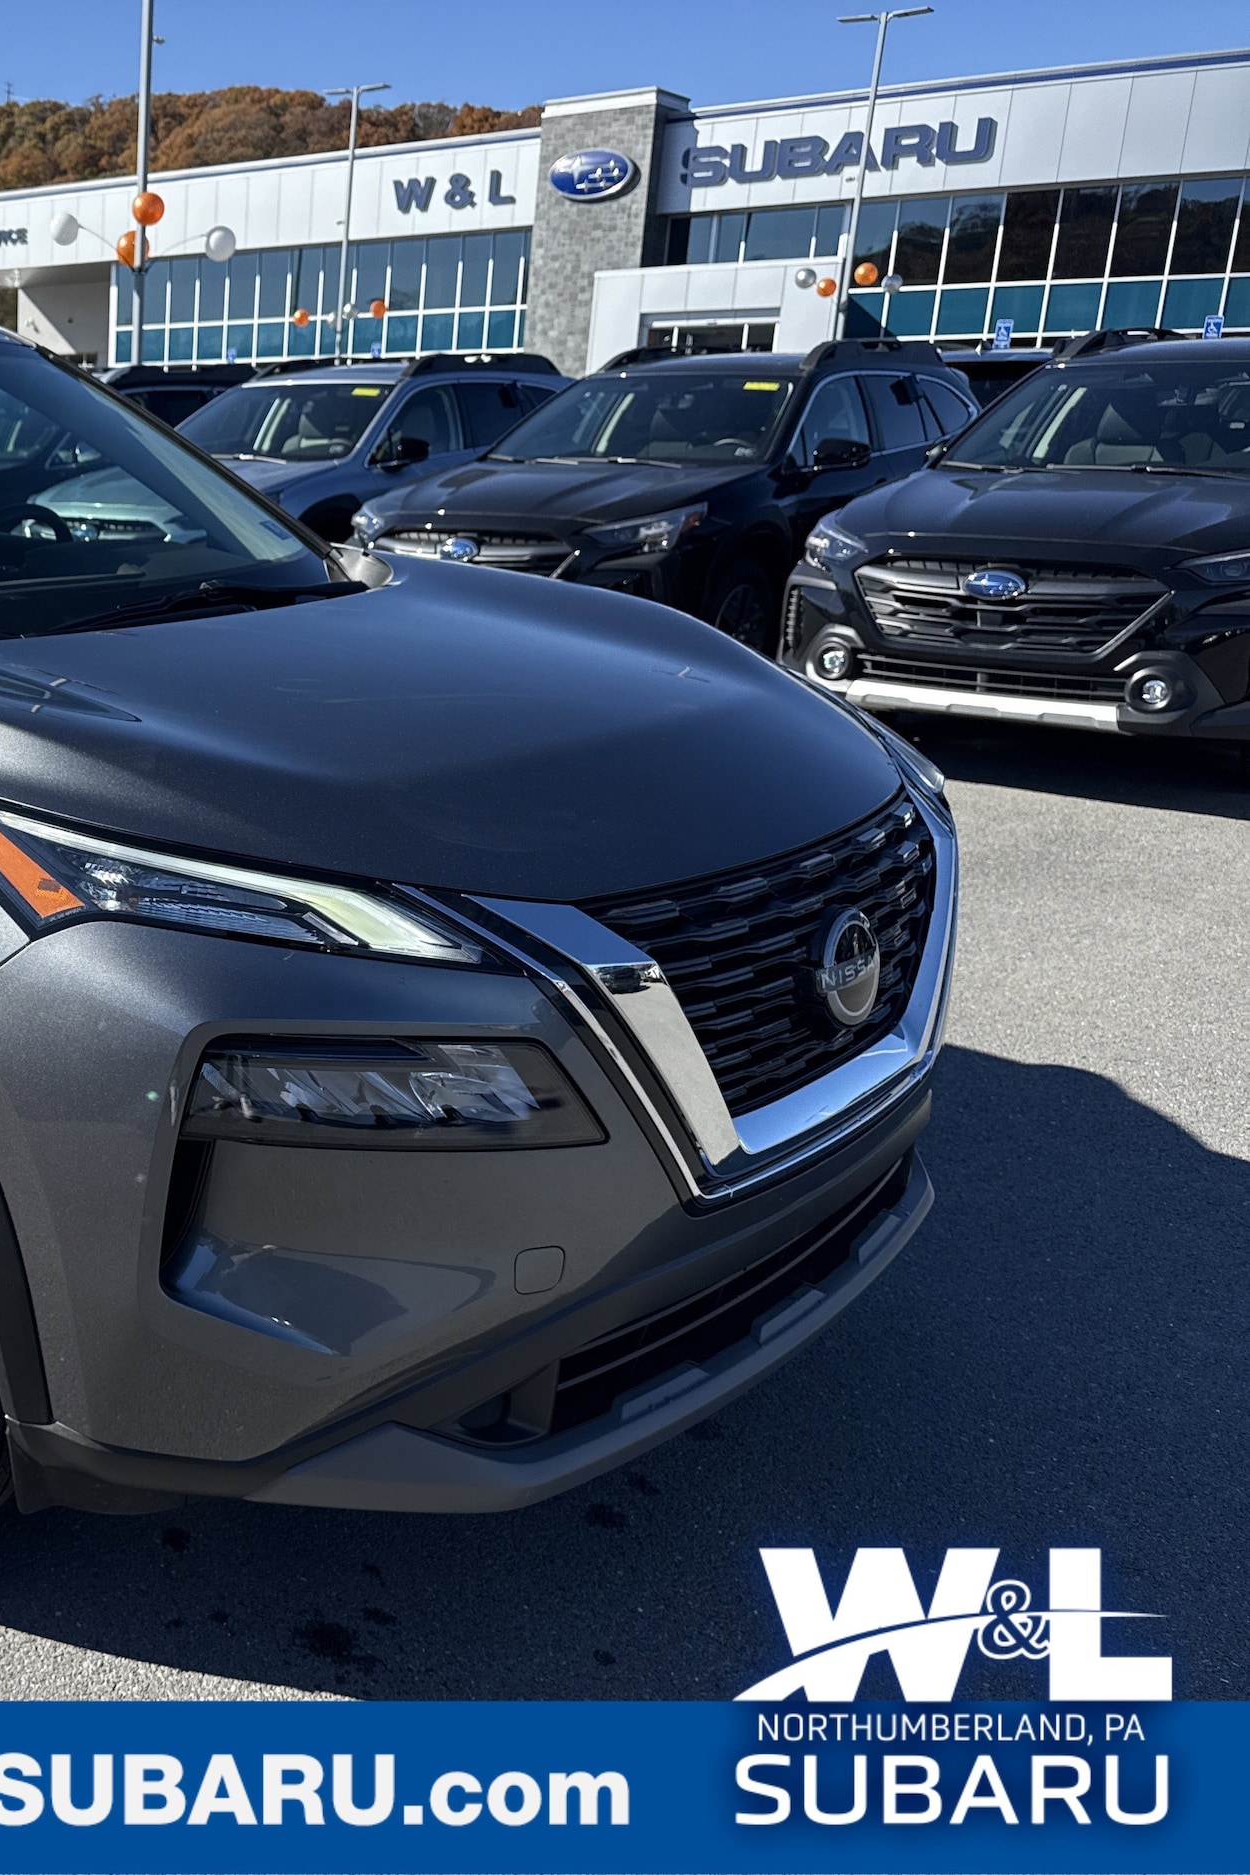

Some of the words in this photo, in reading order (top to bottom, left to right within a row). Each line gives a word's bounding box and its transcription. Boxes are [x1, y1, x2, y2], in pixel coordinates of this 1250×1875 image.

[680, 116, 998, 187] SUBARU
[393, 176, 437, 213] W
[444, 173, 477, 210] &
[489, 169, 516, 206] L
